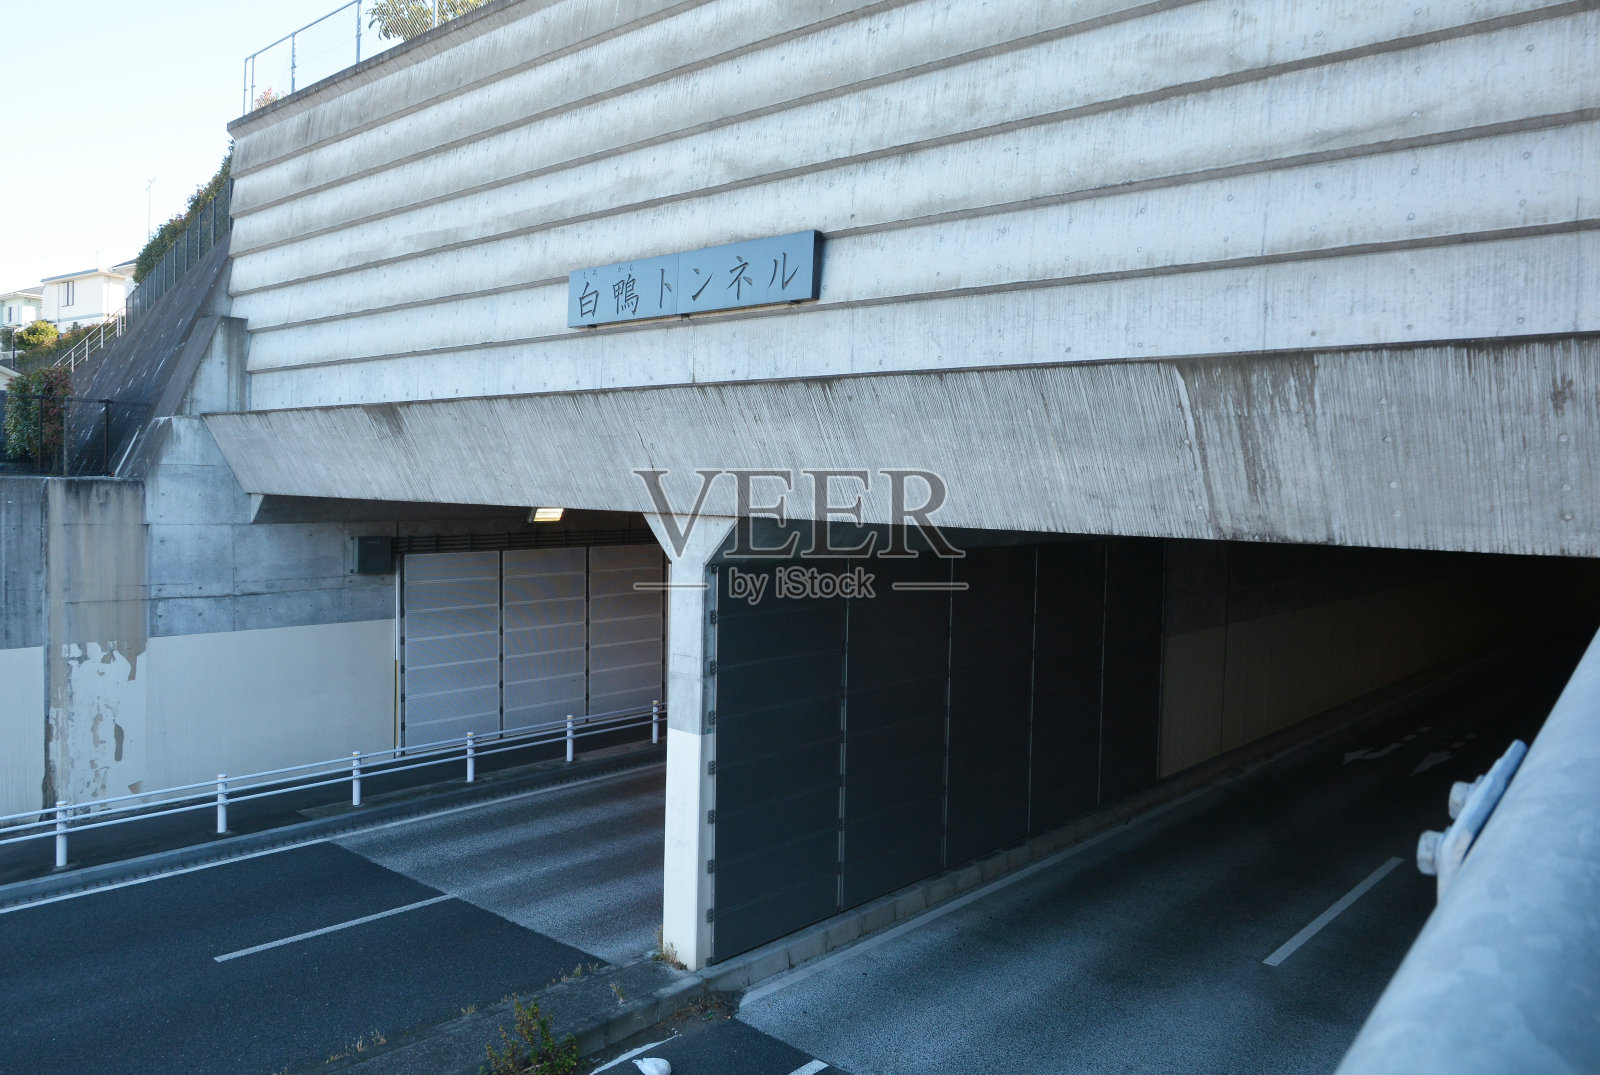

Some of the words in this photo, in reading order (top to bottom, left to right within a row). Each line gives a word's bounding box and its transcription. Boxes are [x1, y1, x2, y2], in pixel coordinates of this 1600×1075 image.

[578, 251, 800, 318] 白鴨トンネル
